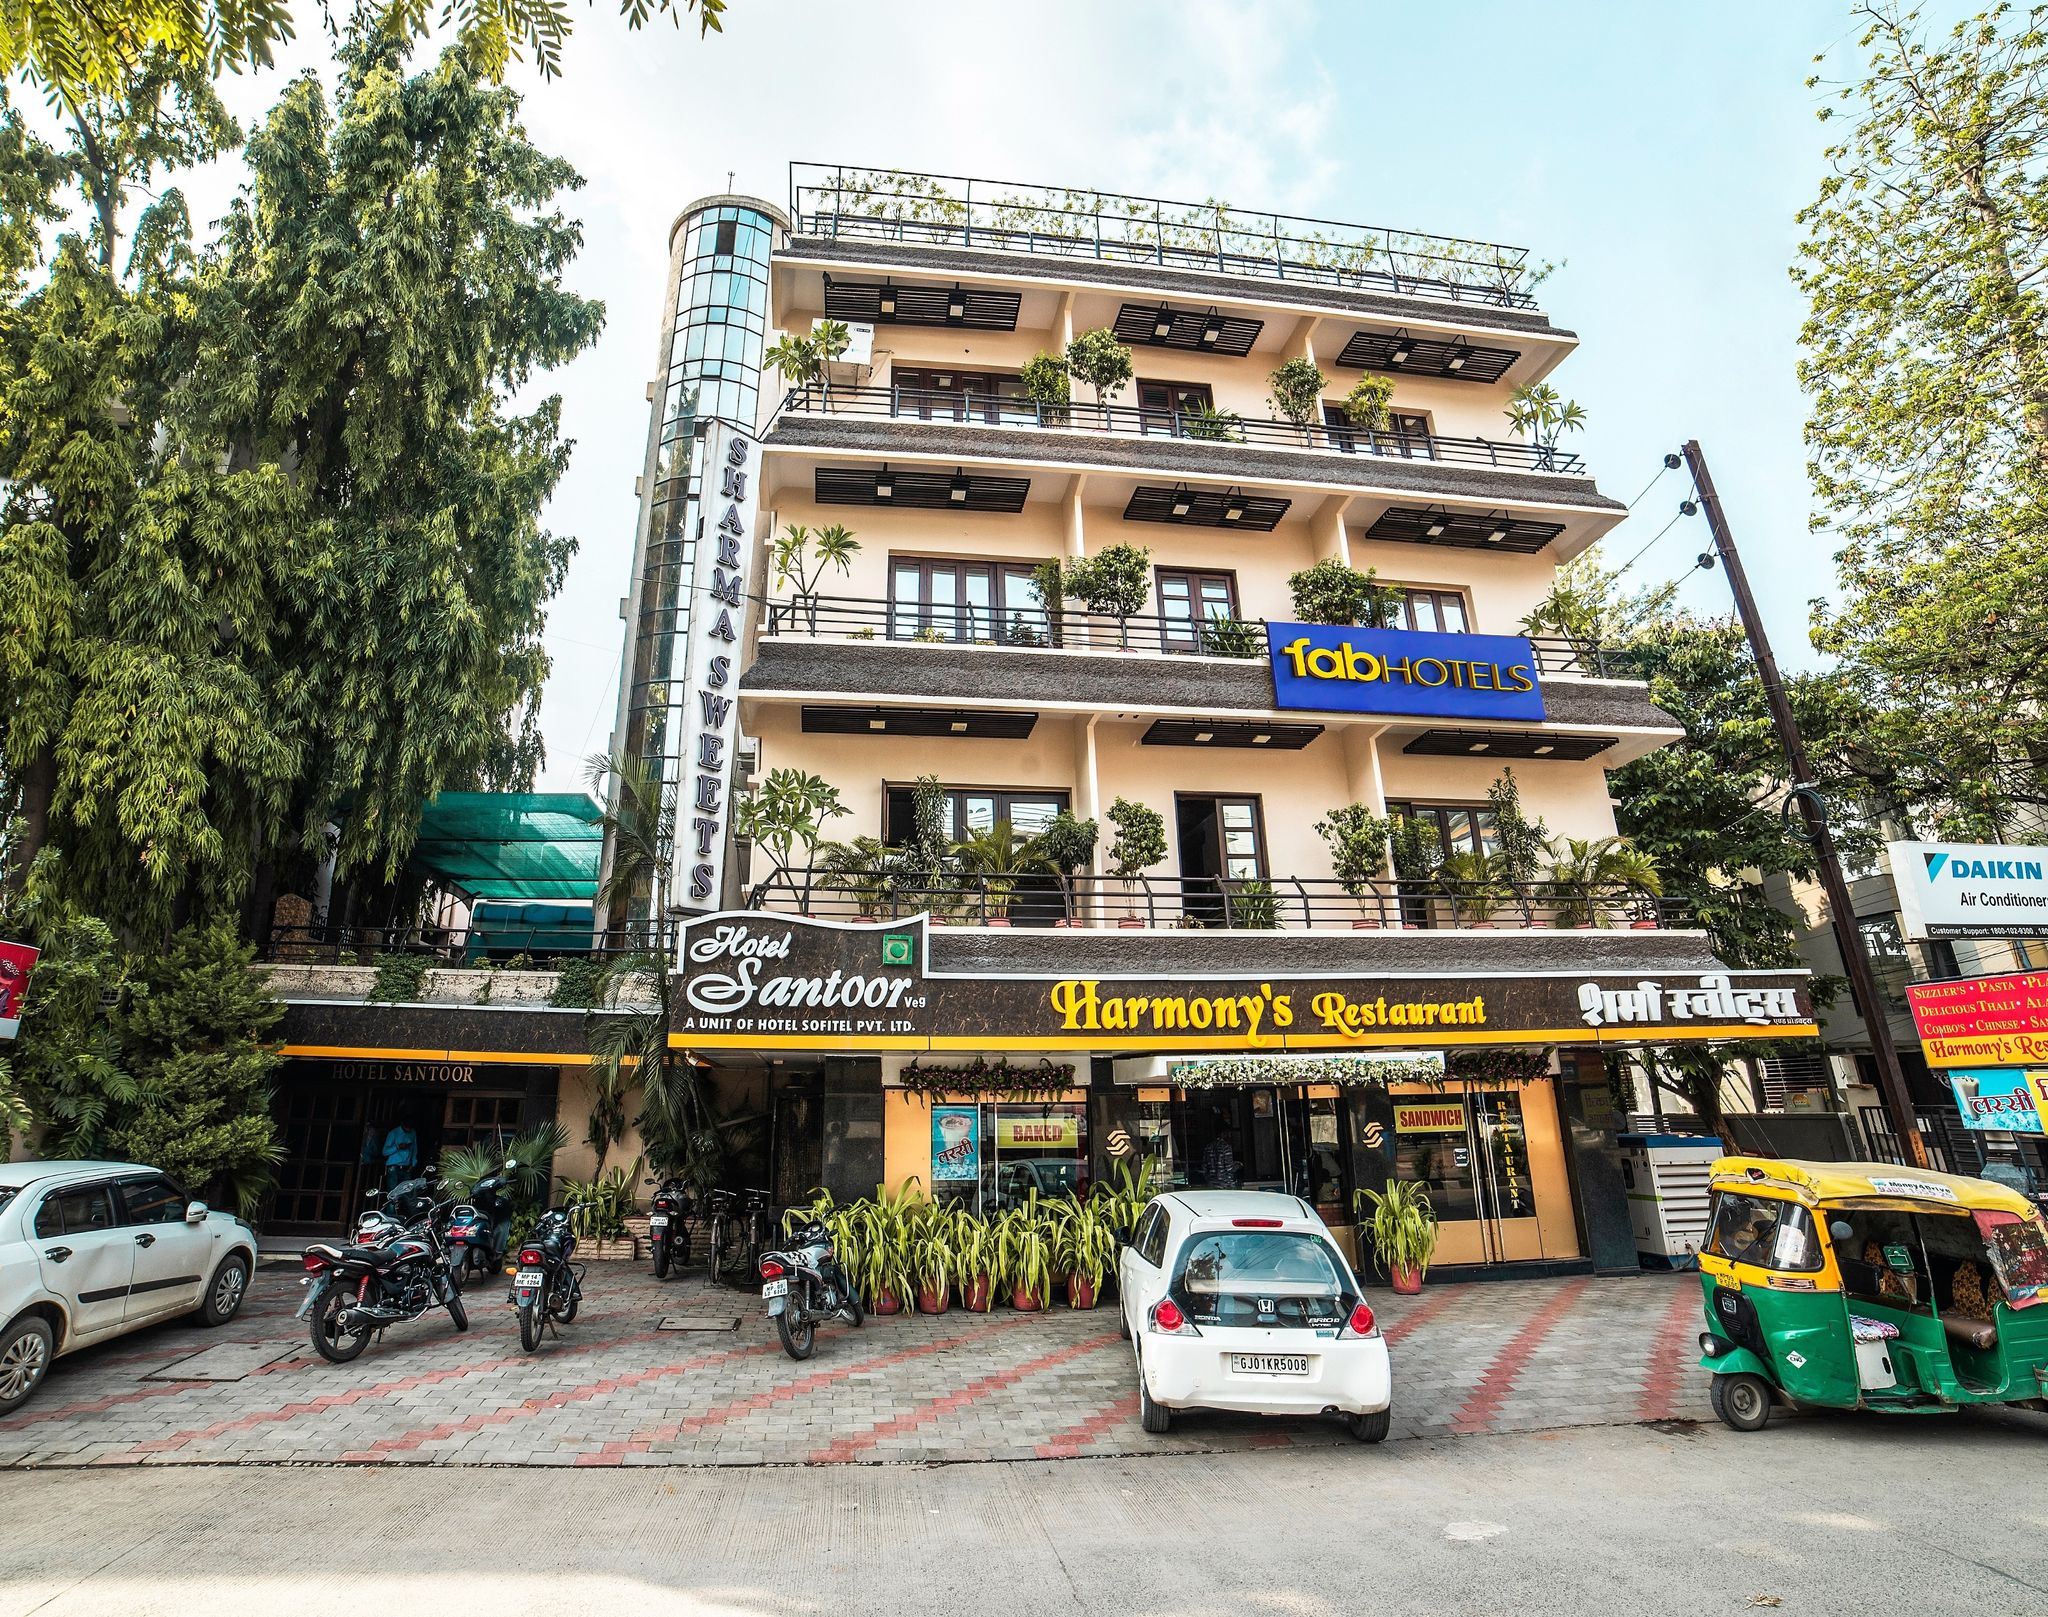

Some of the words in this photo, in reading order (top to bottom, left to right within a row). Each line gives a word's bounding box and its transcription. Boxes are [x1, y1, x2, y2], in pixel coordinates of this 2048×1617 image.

[708, 436, 749, 642] SHARMA
[691, 655, 734, 900] SWEETS
[1951, 860, 2043, 880] DAIKIN
[1961, 892, 1977, 906] Air
[1980, 892, 2048, 907] Conditioner
[1931, 927, 1961, 935] Customer
[690, 925, 793, 962] Hotel
[686, 957, 912, 1013] Santoor
[904, 996, 926, 1008] Veg
[1977, 981, 2016, 993] PASTA
[1577, 980, 1663, 1027] शर्मा
[1918, 1003, 1977, 1017] DELICIOUS
[1976, 1000, 2016, 1012] THALI
[1050, 980, 1294, 1047] Harmony's
[1311, 992, 1487, 1038] Restaurant
[685, 1017, 695, 1029] A
[700, 1018, 732, 1030] UNIT
[737, 1018, 753, 1030] OF
[758, 1019, 798, 1031] HOTEL
[802, 1019, 852, 1031] SOFITEL
[857, 1020, 886, 1032] PVT.
[891, 1020, 916, 1032] LTD.
[1976, 1019, 2020, 1031] CHINESE
[1929, 1037, 2012, 1061] Harmony's
[333, 1063, 387, 1080] HOTEL
[394, 1065, 474, 1082] SANTOOR
[1400, 1110, 1462, 1127] SANDWICH
[1013, 1125, 1062, 1142] BAKED
[1497, 1101, 1520, 1208] RESTAURANT
[1240, 1357, 1307, 1371] GJ01KR5008
